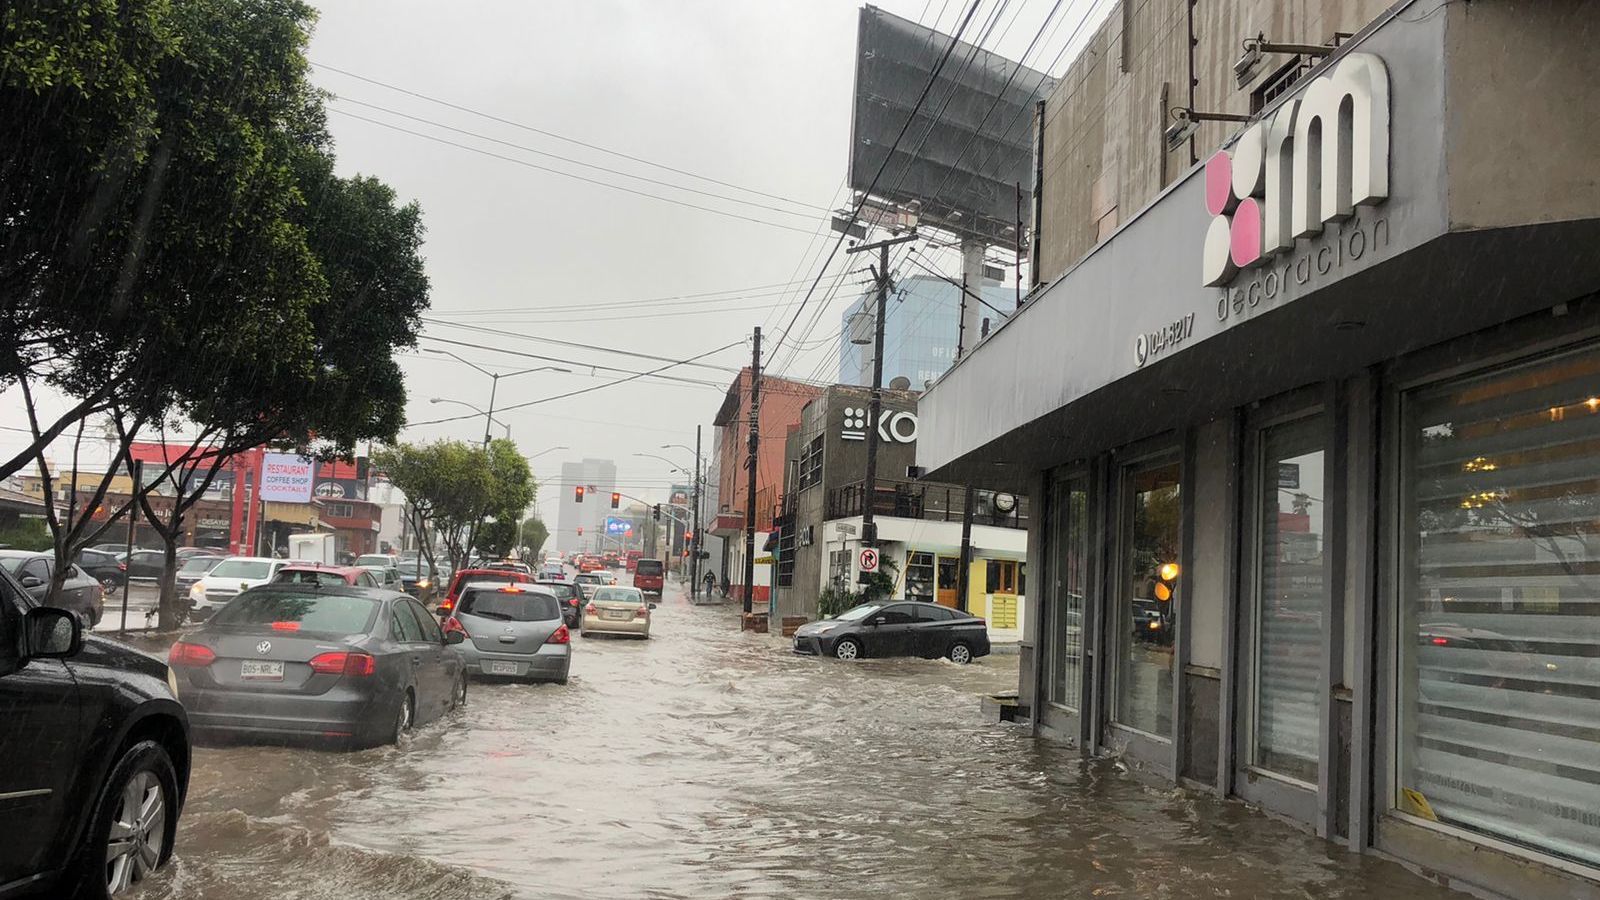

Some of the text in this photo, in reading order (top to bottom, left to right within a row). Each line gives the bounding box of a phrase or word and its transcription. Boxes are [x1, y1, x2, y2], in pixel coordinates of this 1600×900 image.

[1216, 216, 1389, 321] decoración
[1149, 312, 1195, 355] 104-8217
[267, 463, 309, 475] RESTAURANT
[266, 475, 308, 485] COFFEE SHOP
[266, 485, 308, 494] COCKTAILS
